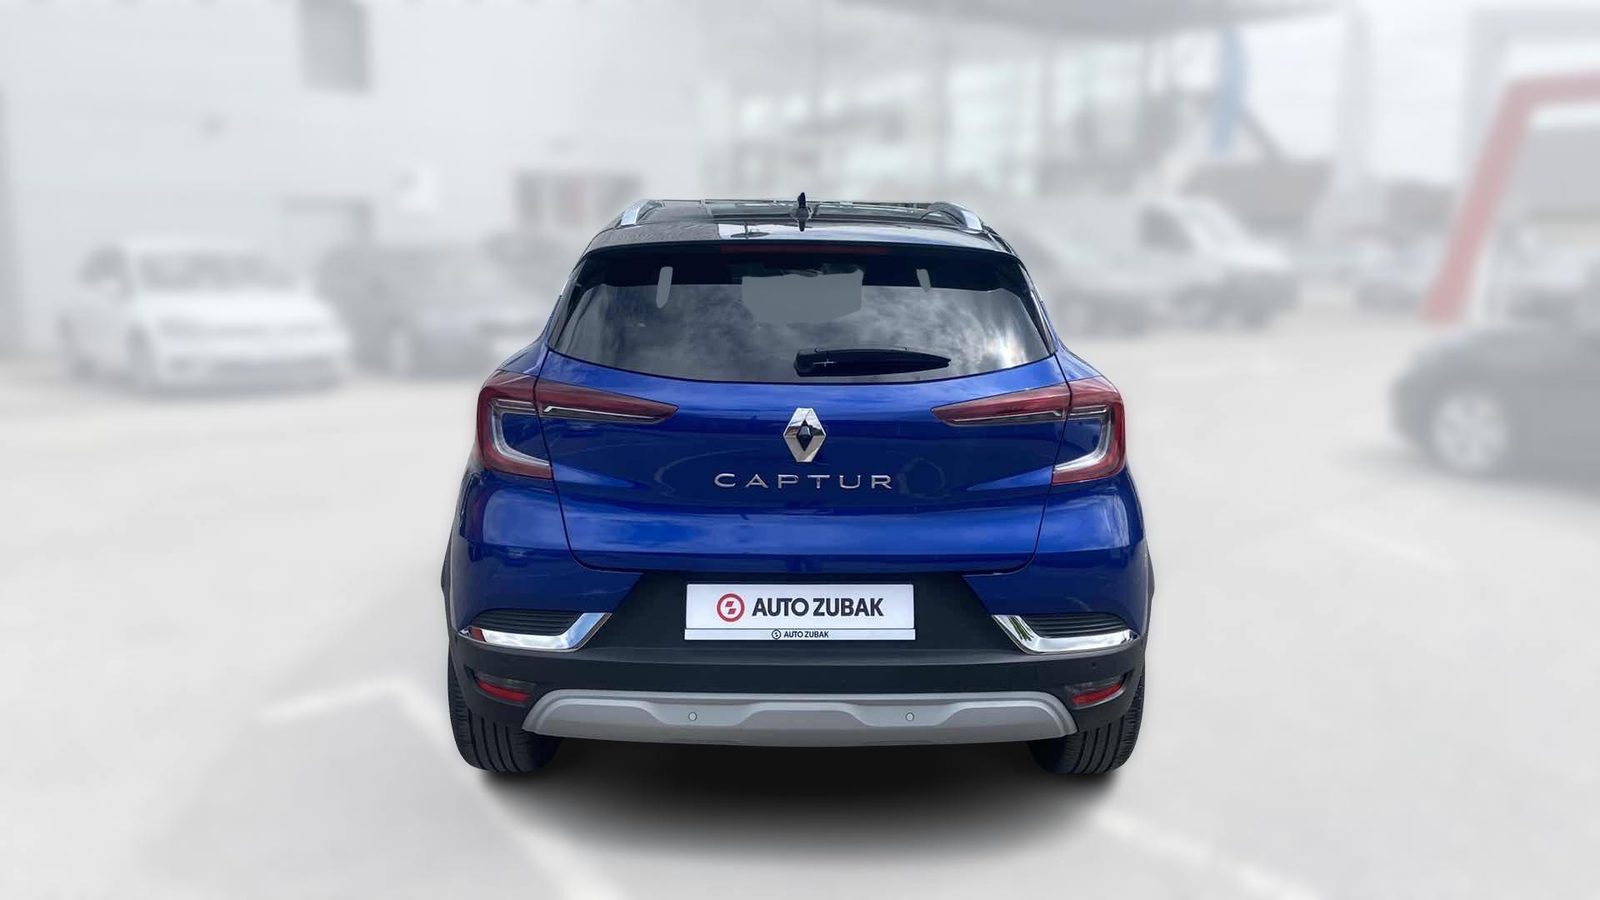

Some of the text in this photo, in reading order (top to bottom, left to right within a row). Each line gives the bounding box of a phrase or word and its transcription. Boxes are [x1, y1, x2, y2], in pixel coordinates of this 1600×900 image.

[714, 473, 892, 489] CAPTUR
[752, 597, 884, 617] AUTO ZUBAK
[783, 630, 829, 638] AUTO ZUBAK
